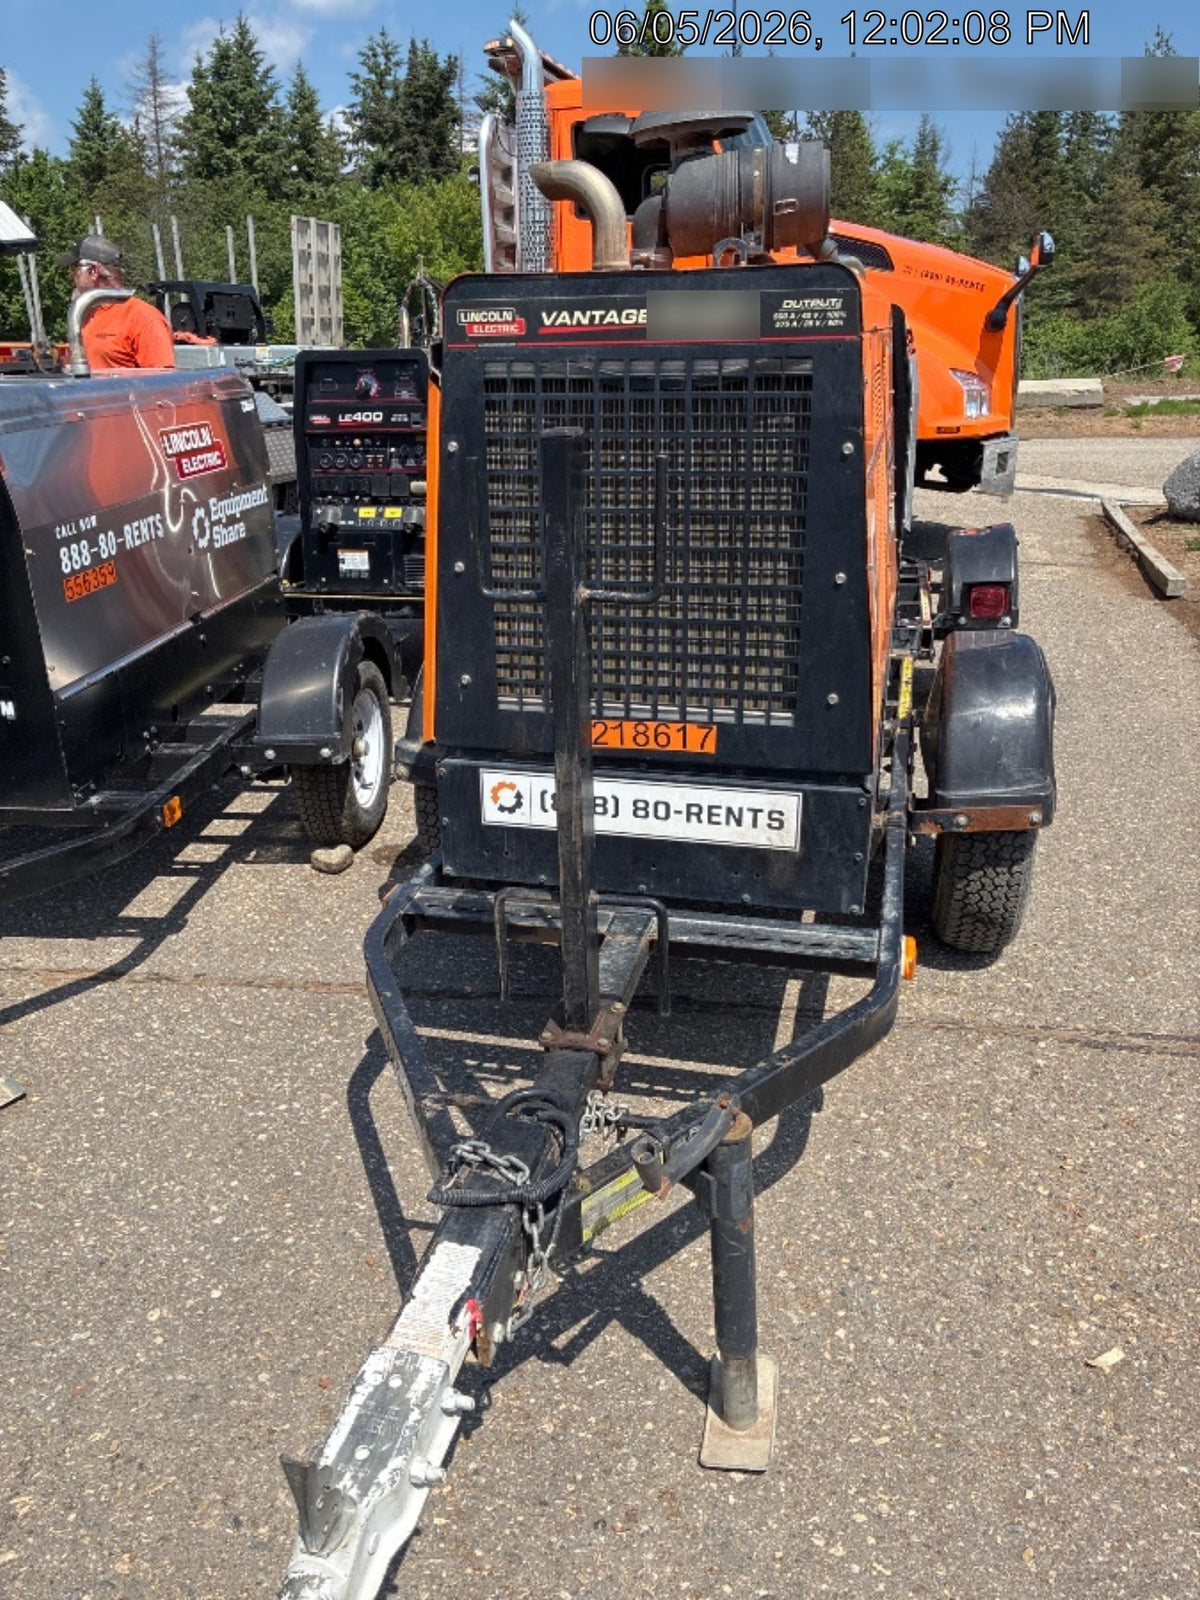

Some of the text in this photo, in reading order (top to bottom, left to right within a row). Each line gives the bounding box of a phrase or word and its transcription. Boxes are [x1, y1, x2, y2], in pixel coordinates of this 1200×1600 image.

[460, 310, 513, 323] LINCOLN
[473, 324, 520, 334] ELECTRIC
[162, 426, 212, 455] LINCOLN
[181, 450, 223, 474] ELECTRIC
[208, 483, 269, 522] Equipment
[55, 525, 77, 539] CALL
[60, 513, 164, 574] 888-80-RENTS
[212, 522, 246, 548] Share
[65, 562, 116, 600] 556359
[592, 721, 713, 750] 218617
[540, 788, 786, 831] (8) 80-RENTS
